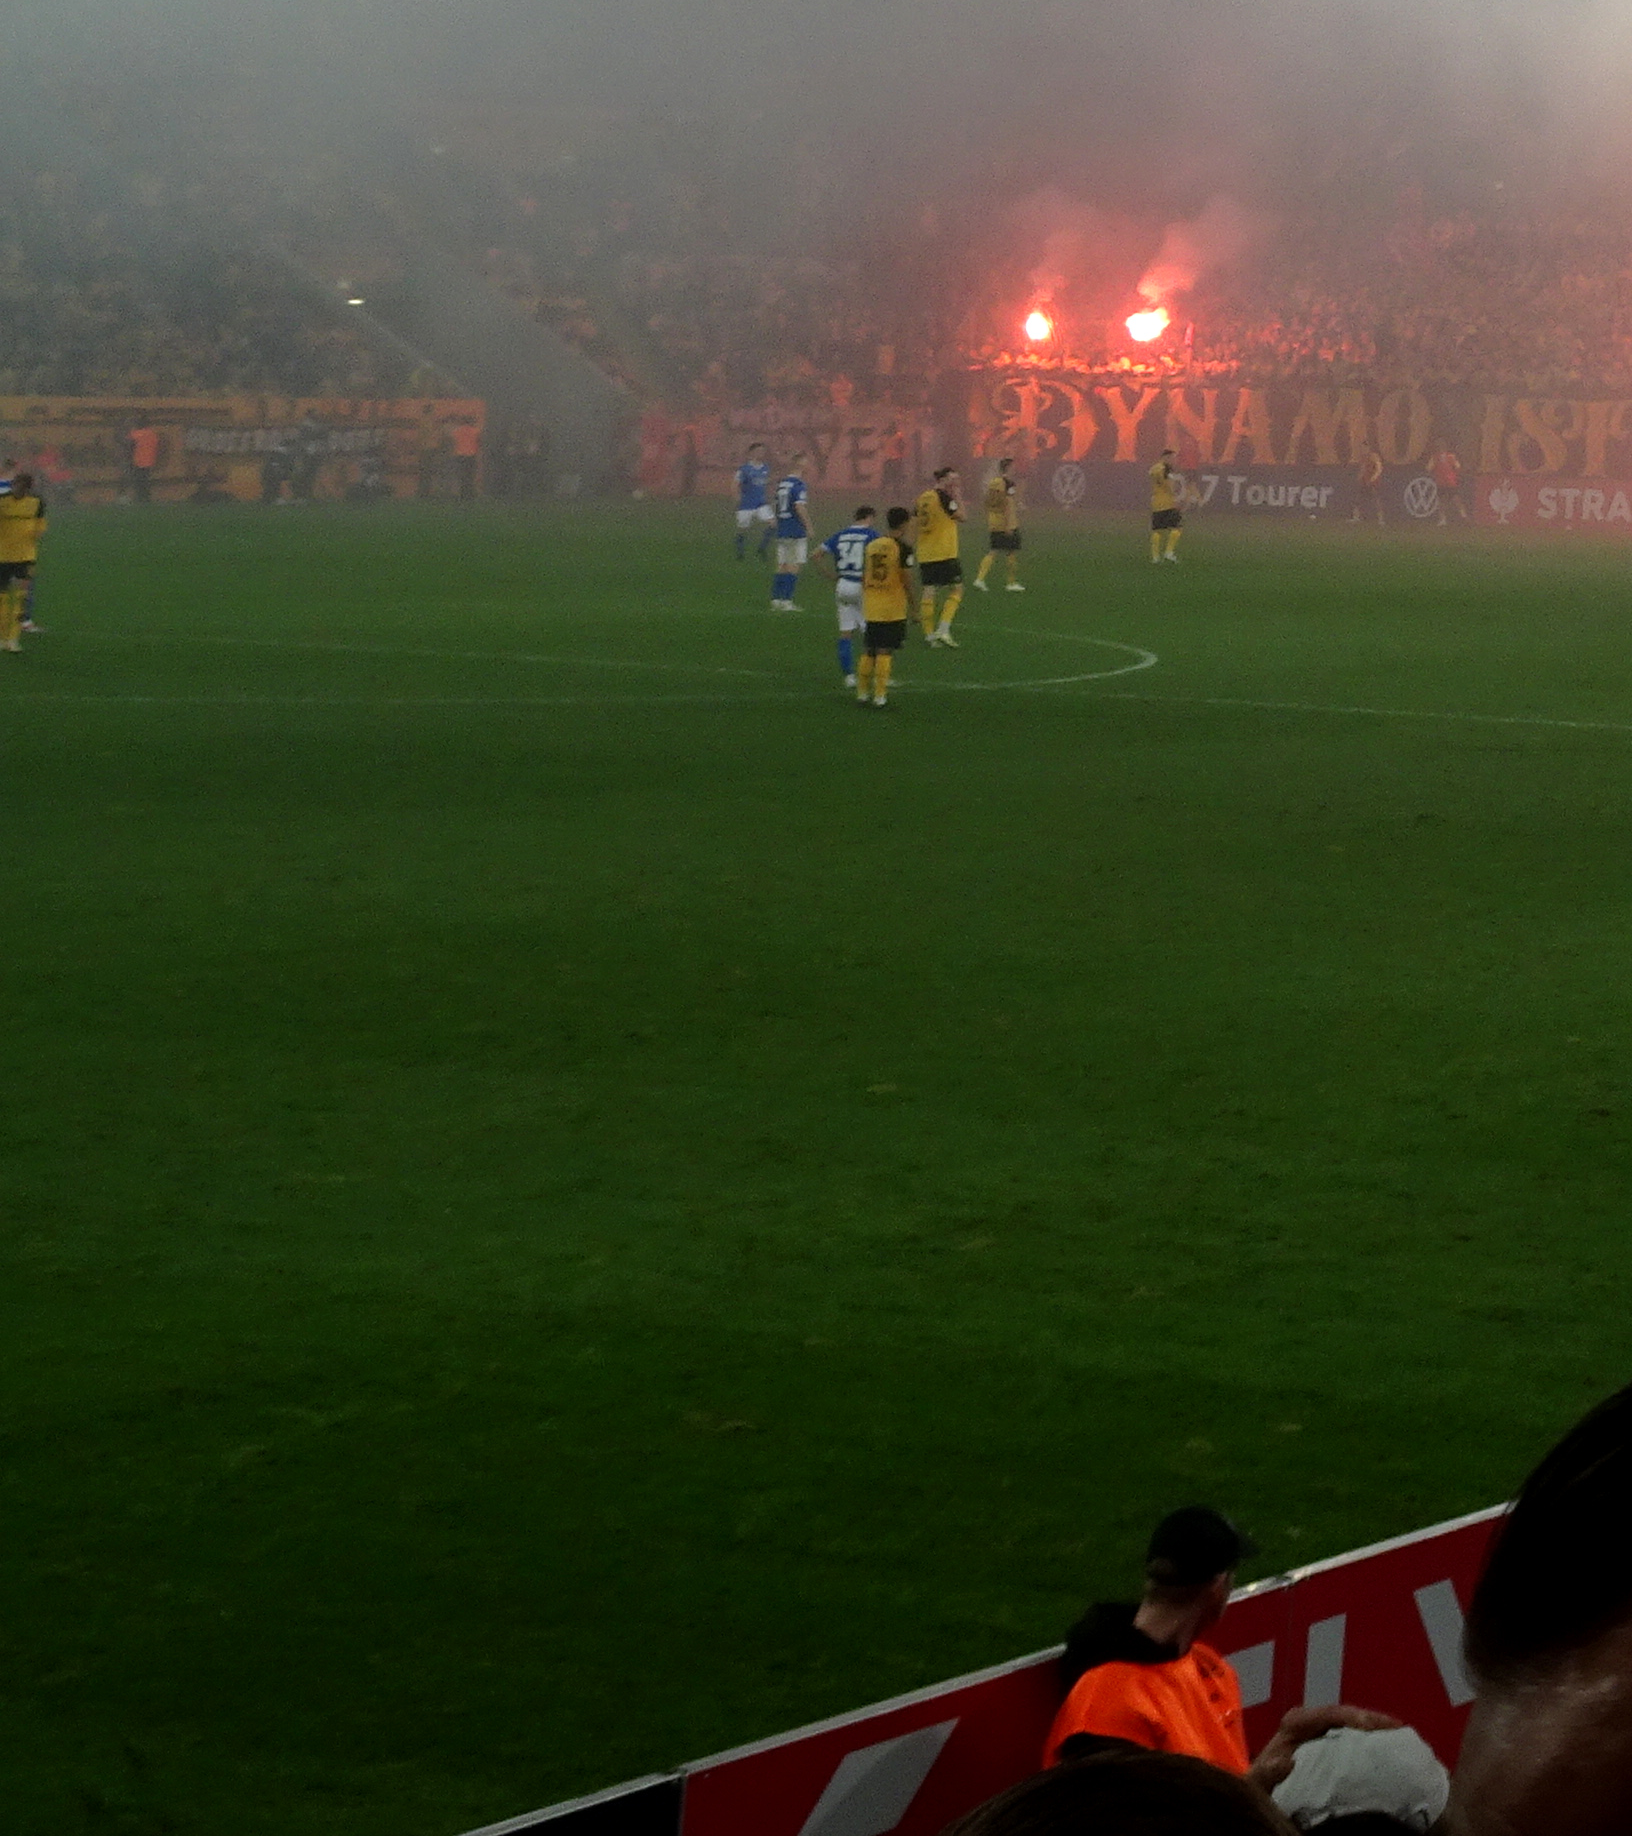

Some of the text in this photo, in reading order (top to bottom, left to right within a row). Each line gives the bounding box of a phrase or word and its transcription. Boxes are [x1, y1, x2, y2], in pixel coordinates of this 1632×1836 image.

[991, 376, 1434, 464] DYNAMO
[1480, 393, 1632, 476] IST
[1227, 475, 1334, 508] Tourer
